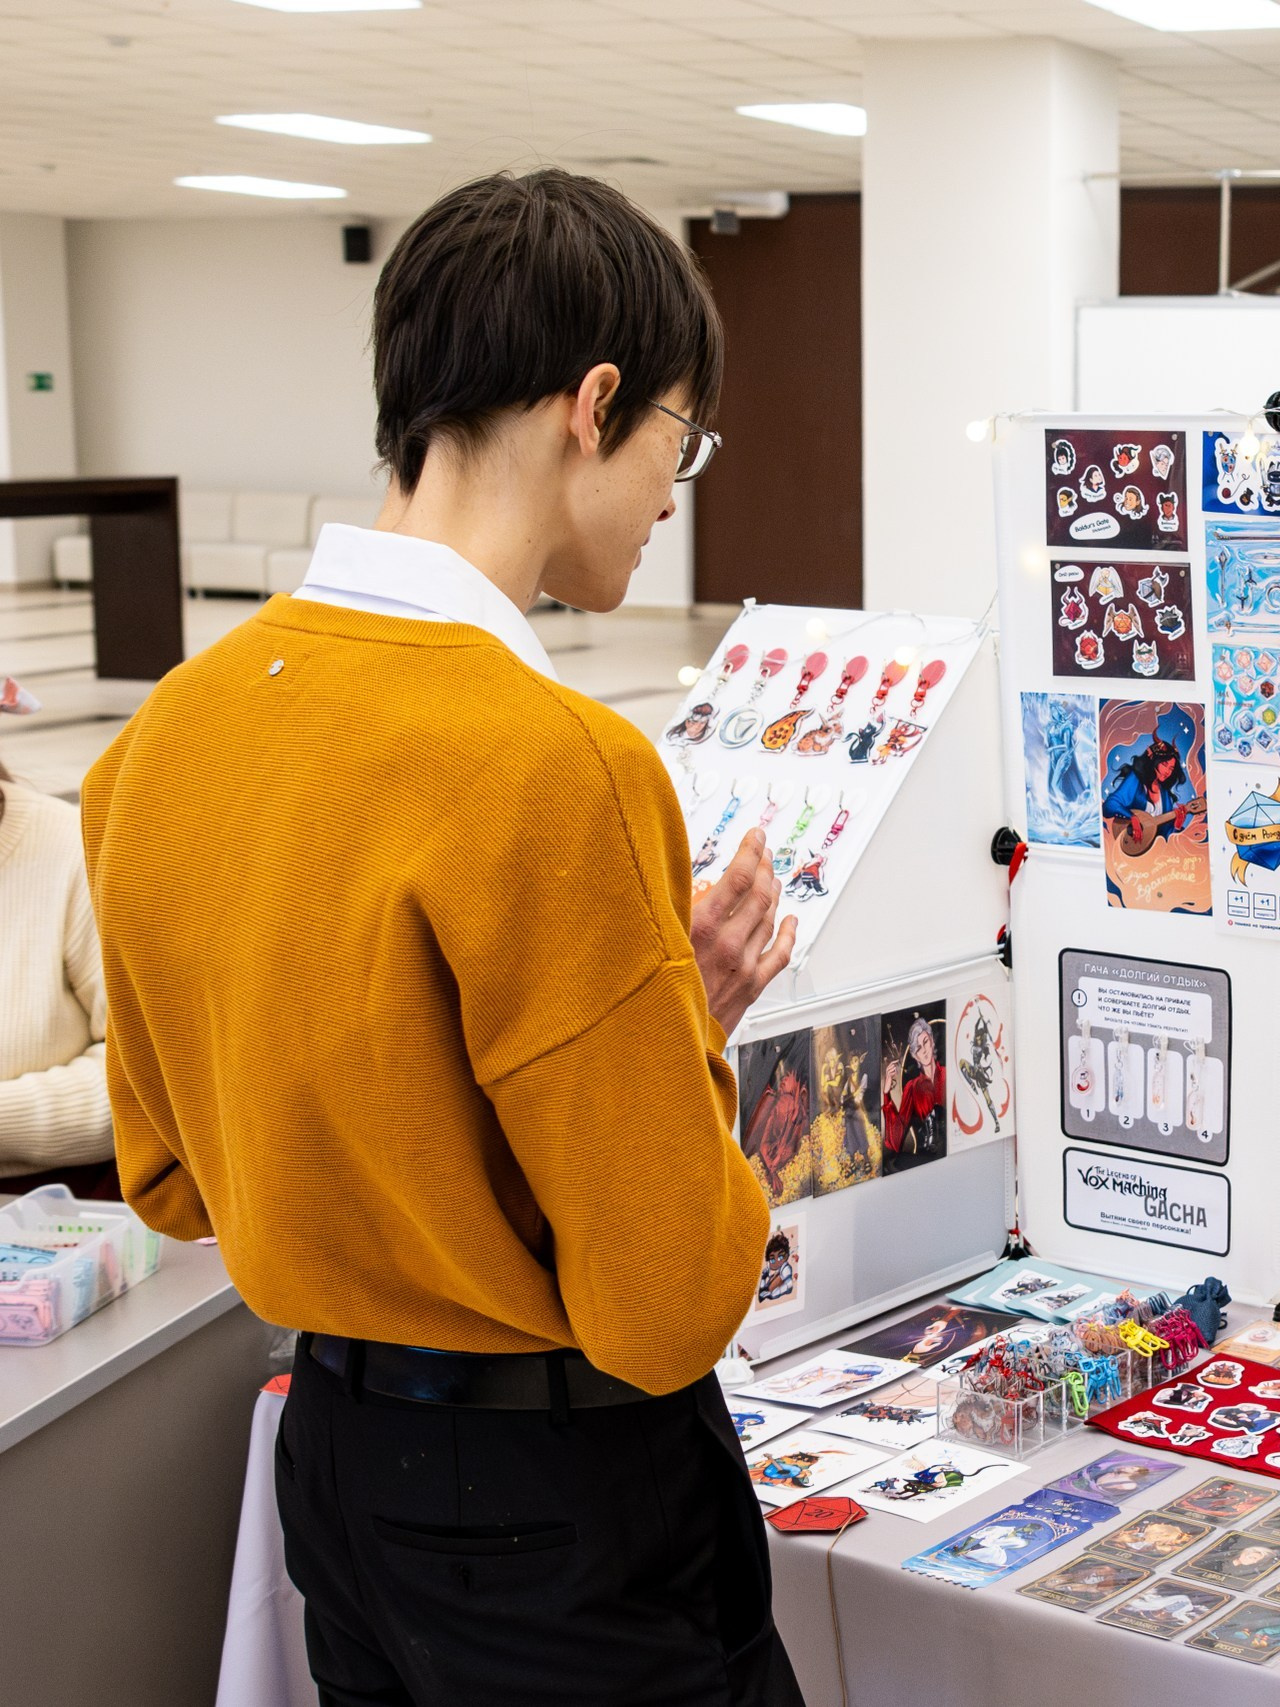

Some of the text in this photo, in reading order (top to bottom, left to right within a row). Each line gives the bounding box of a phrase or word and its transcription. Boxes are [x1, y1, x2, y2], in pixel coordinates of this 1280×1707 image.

[1084, 963, 1207, 988] ГАЧА «ДОЛГИЙ ОТДЫХ»
[1109, 988, 1154, 1001] ОСТАНОВИЛИСЬ
[1165, 996, 1191, 1006] ПРИВАЛЕ
[1104, 997, 1140, 1008] СОВЕРШАЕТЕ
[1142, 1002, 1166, 1012] ДОЛГИЙ
[1122, 1008, 1132, 1016] ВЫ
[1132, 1009, 1154, 1019] ПЬЁТЕ?
[1124, 1116, 1130, 1125] 2
[1162, 1122, 1169, 1132] 3
[1201, 1130, 1208, 1139] 4
[1144, 1195, 1208, 1228] GACHA
[1100, 1212, 1126, 1222] Вытяни
[1128, 1216, 1151, 1228] своего
[1152, 1222, 1192, 1236] персонажа!
[804, 1508, 834, 1518] 20
[1214, 1642, 1244, 1654] PISCES
